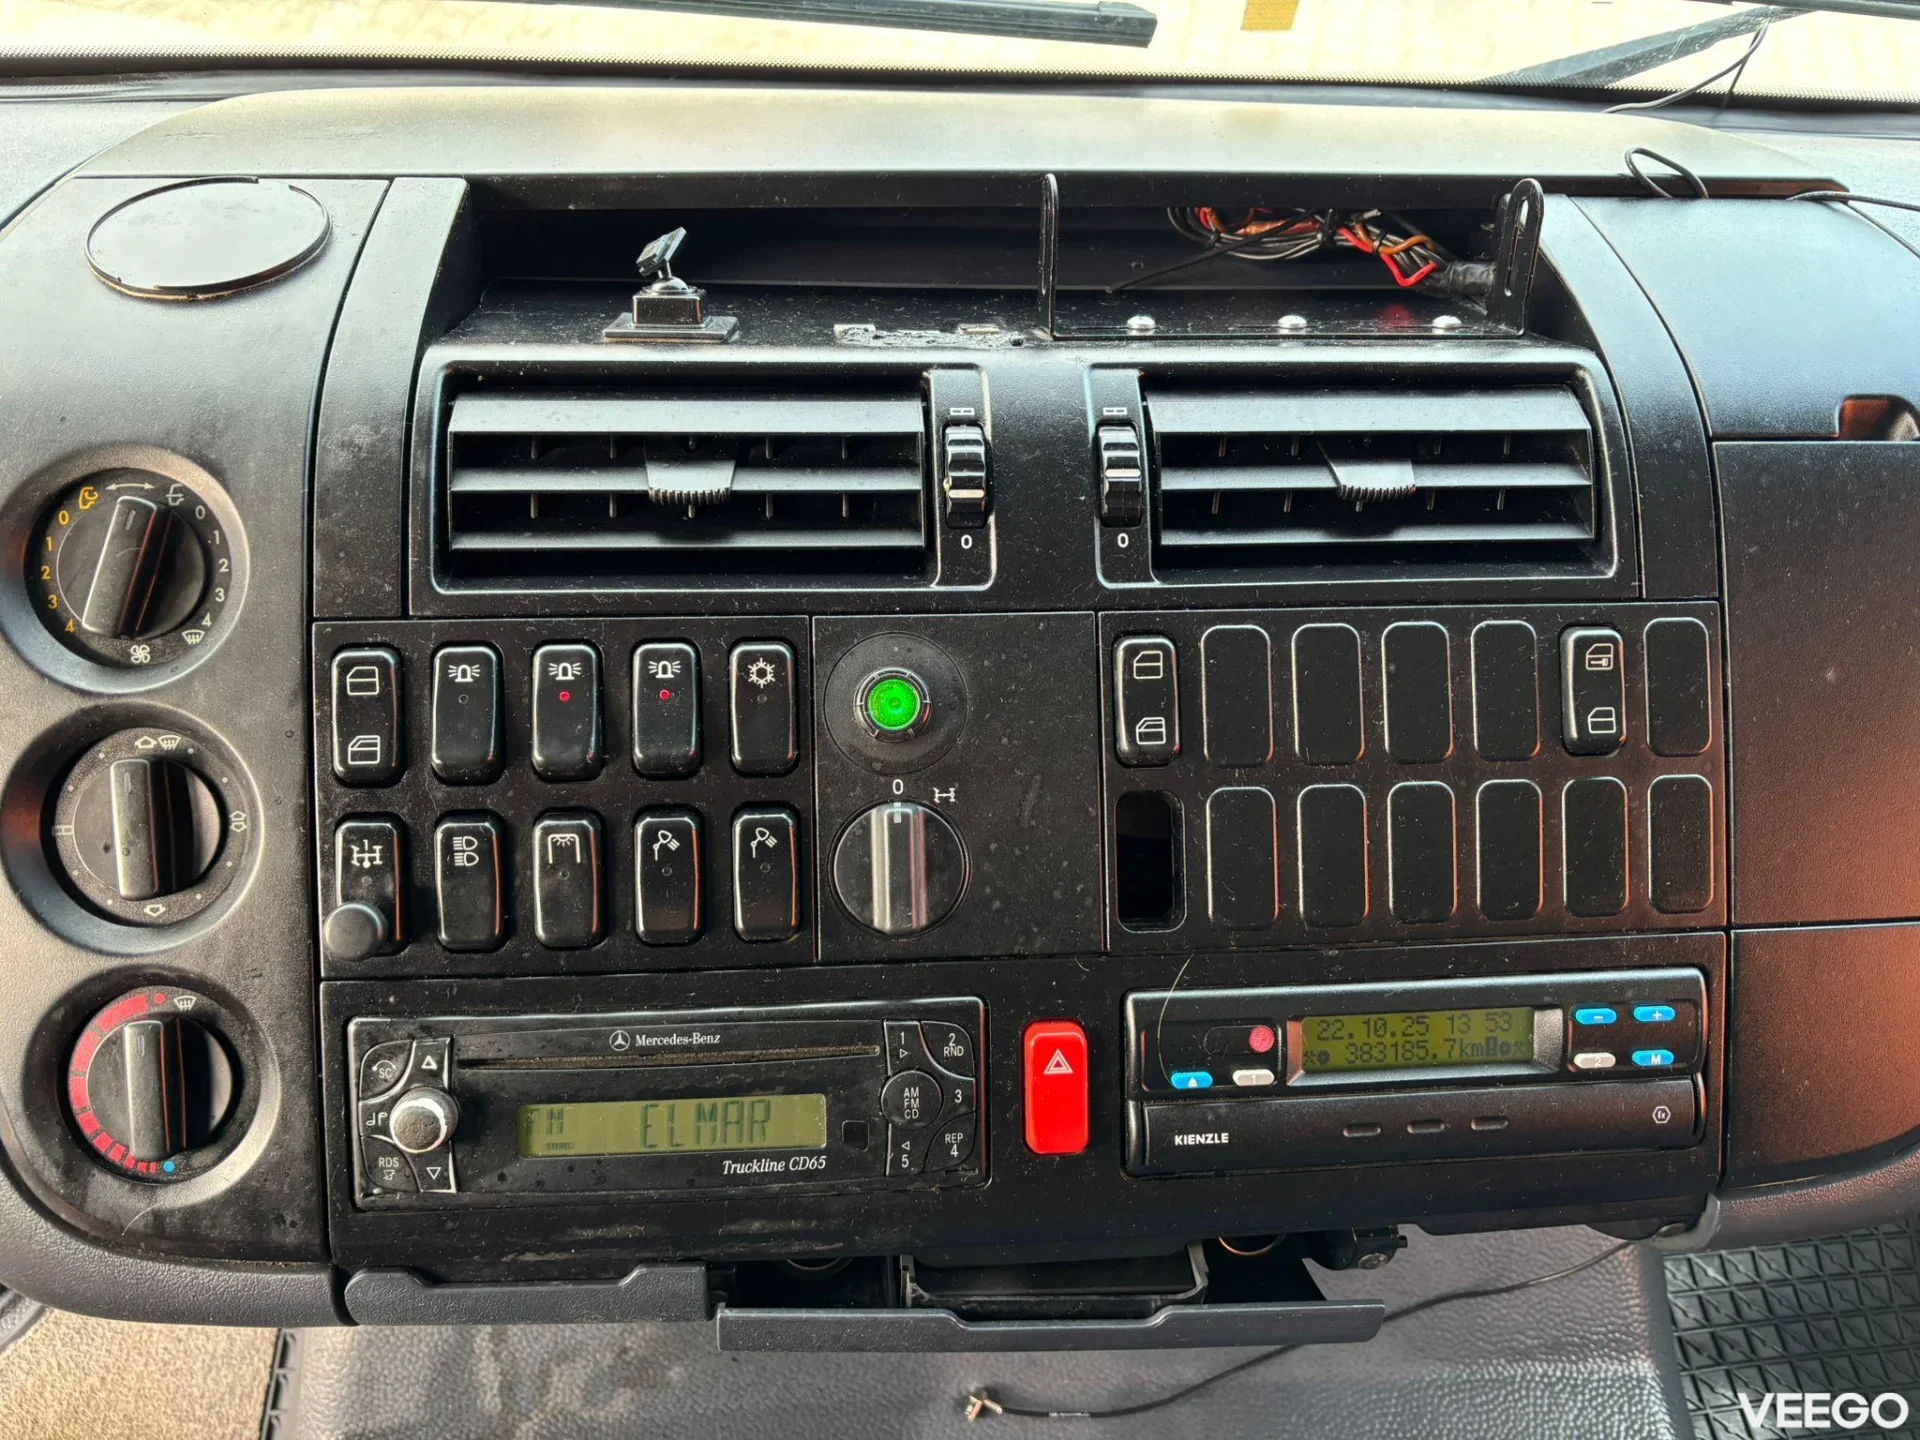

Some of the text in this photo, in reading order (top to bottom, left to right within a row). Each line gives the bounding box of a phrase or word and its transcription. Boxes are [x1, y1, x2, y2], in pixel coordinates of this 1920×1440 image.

[58, 511, 70, 525] 0
[195, 505, 206, 520] 0
[46, 537, 53, 551] 1
[213, 530, 220, 545] 1
[960, 534, 973, 549] 0
[1117, 533, 1130, 548] 0
[41, 565, 51, 580] 2
[218, 558, 230, 573] 2
[48, 594, 58, 609] 3
[215, 588, 226, 602] 3
[65, 618, 76, 633] 4
[202, 612, 213, 627] 4
[892, 779, 904, 795] 0
[1316, 1014, 1430, 1042] 22.10.25
[635, 1032, 721, 1047] Mercedes-Benz
[900, 1031, 906, 1045] 1
[948, 1033, 957, 1046] 2
[943, 1046, 965, 1057] RND
[1594, 1057, 1601, 1067] 2
[1651, 1055, 1661, 1064] M
[378, 1068, 393, 1079] SC
[903, 1087, 920, 1098] AM
[954, 1089, 963, 1103] 3
[904, 1099, 920, 1109] FM
[904, 1109, 919, 1119] CD
[638, 1099, 772, 1149] ELMAR
[944, 1133, 964, 1144] REP
[1174, 1132, 1230, 1146] KIENZLE
[950, 1144, 959, 1157] 4
[378, 1157, 399, 1168] RDS
[722, 1155, 827, 1175] Truckline CD65
[901, 1154, 909, 1168] 5
